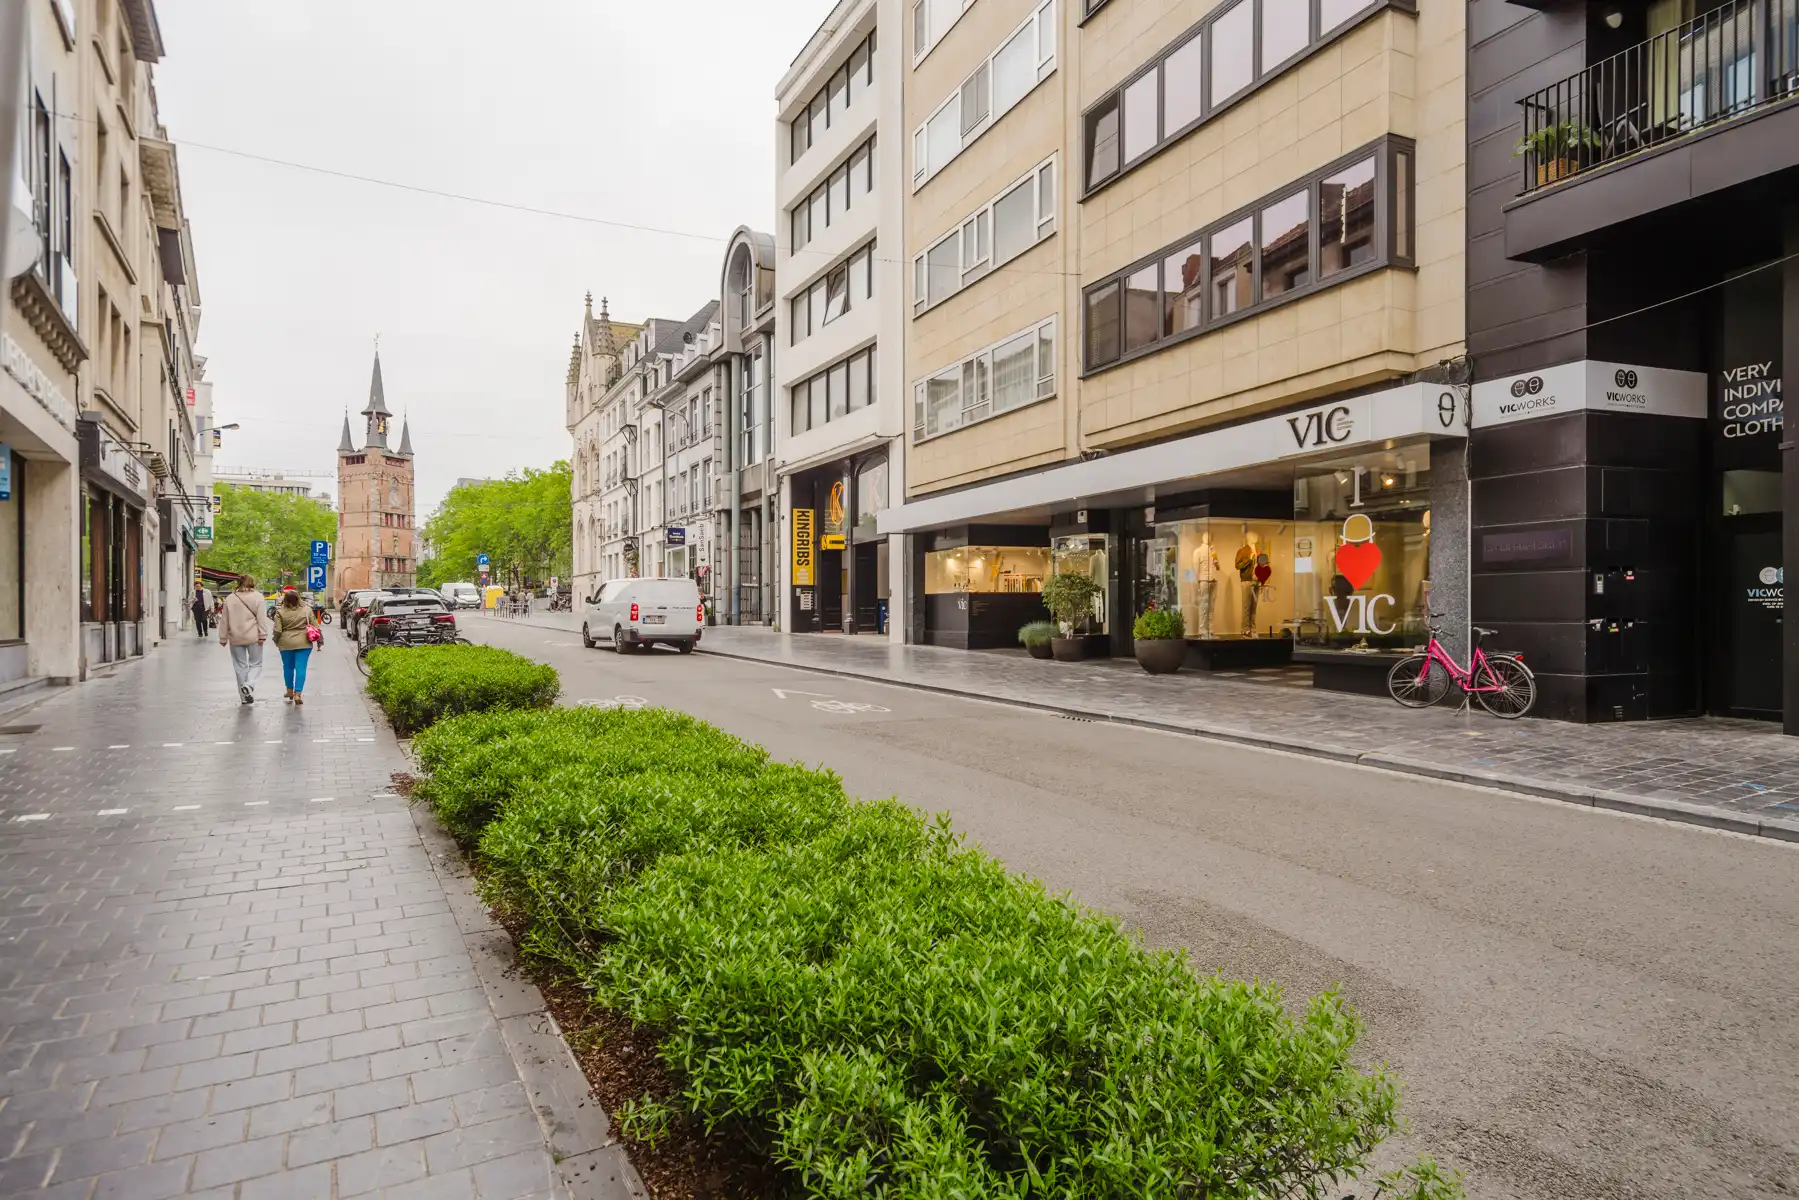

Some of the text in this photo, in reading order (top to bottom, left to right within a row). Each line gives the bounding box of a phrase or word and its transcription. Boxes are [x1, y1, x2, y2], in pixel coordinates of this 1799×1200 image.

[1722, 361, 1773, 383] VERY
[1606, 391, 1646, 404] VICWORKS
[1724, 378, 1781, 402] INDIVI
[1499, 395, 1556, 415] VICWORKS
[1287, 406, 1351, 448] VIC
[1723, 416, 1783, 438] CLOTH
[1350, 466, 1365, 507] I
[316, 542, 324, 553] P
[796, 510, 810, 566] KINGRIBS
[311, 567, 324, 584] P
[1323, 593, 1397, 635] VIC
